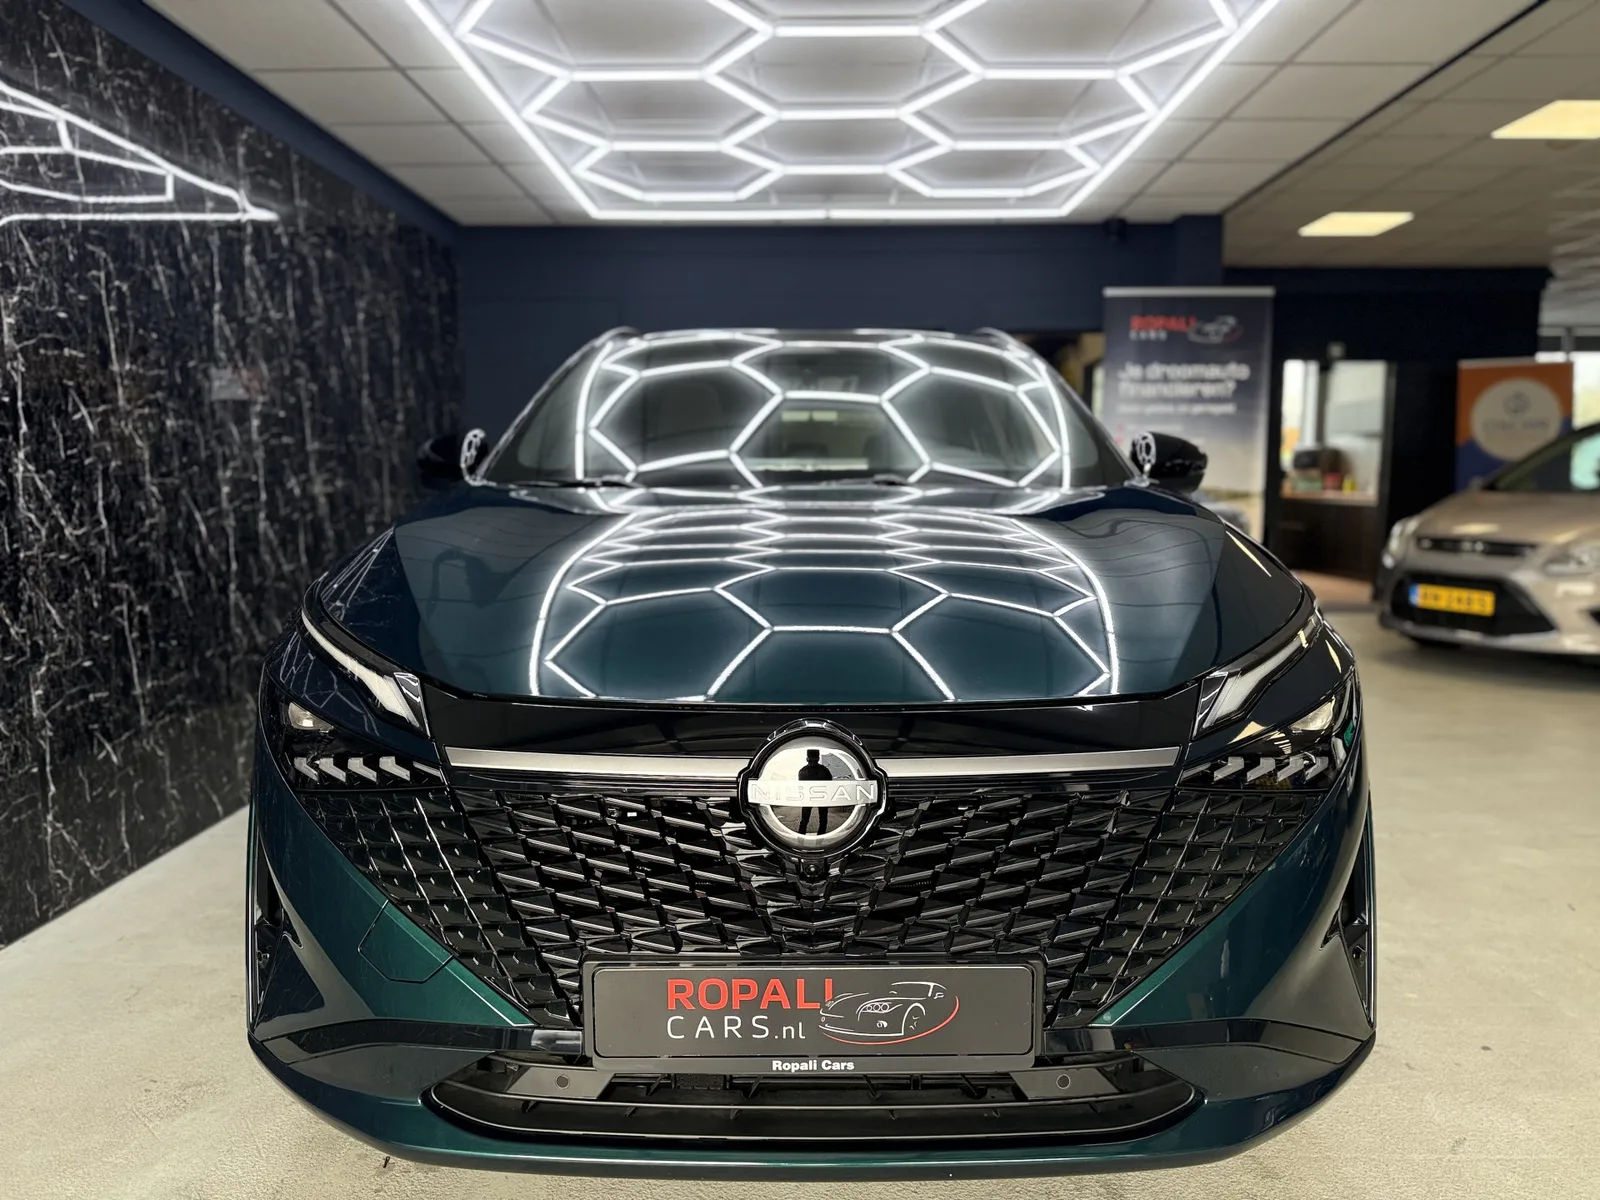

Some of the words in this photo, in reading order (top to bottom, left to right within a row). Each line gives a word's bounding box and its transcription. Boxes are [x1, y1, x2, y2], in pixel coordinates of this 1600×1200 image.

[751, 784, 874, 801] NISSAN
[667, 978, 833, 1010] ROPALI
[666, 1016, 806, 1039] CARS.nl
[772, 1060, 817, 1073] Ropali
[821, 1060, 855, 1071] Cars
